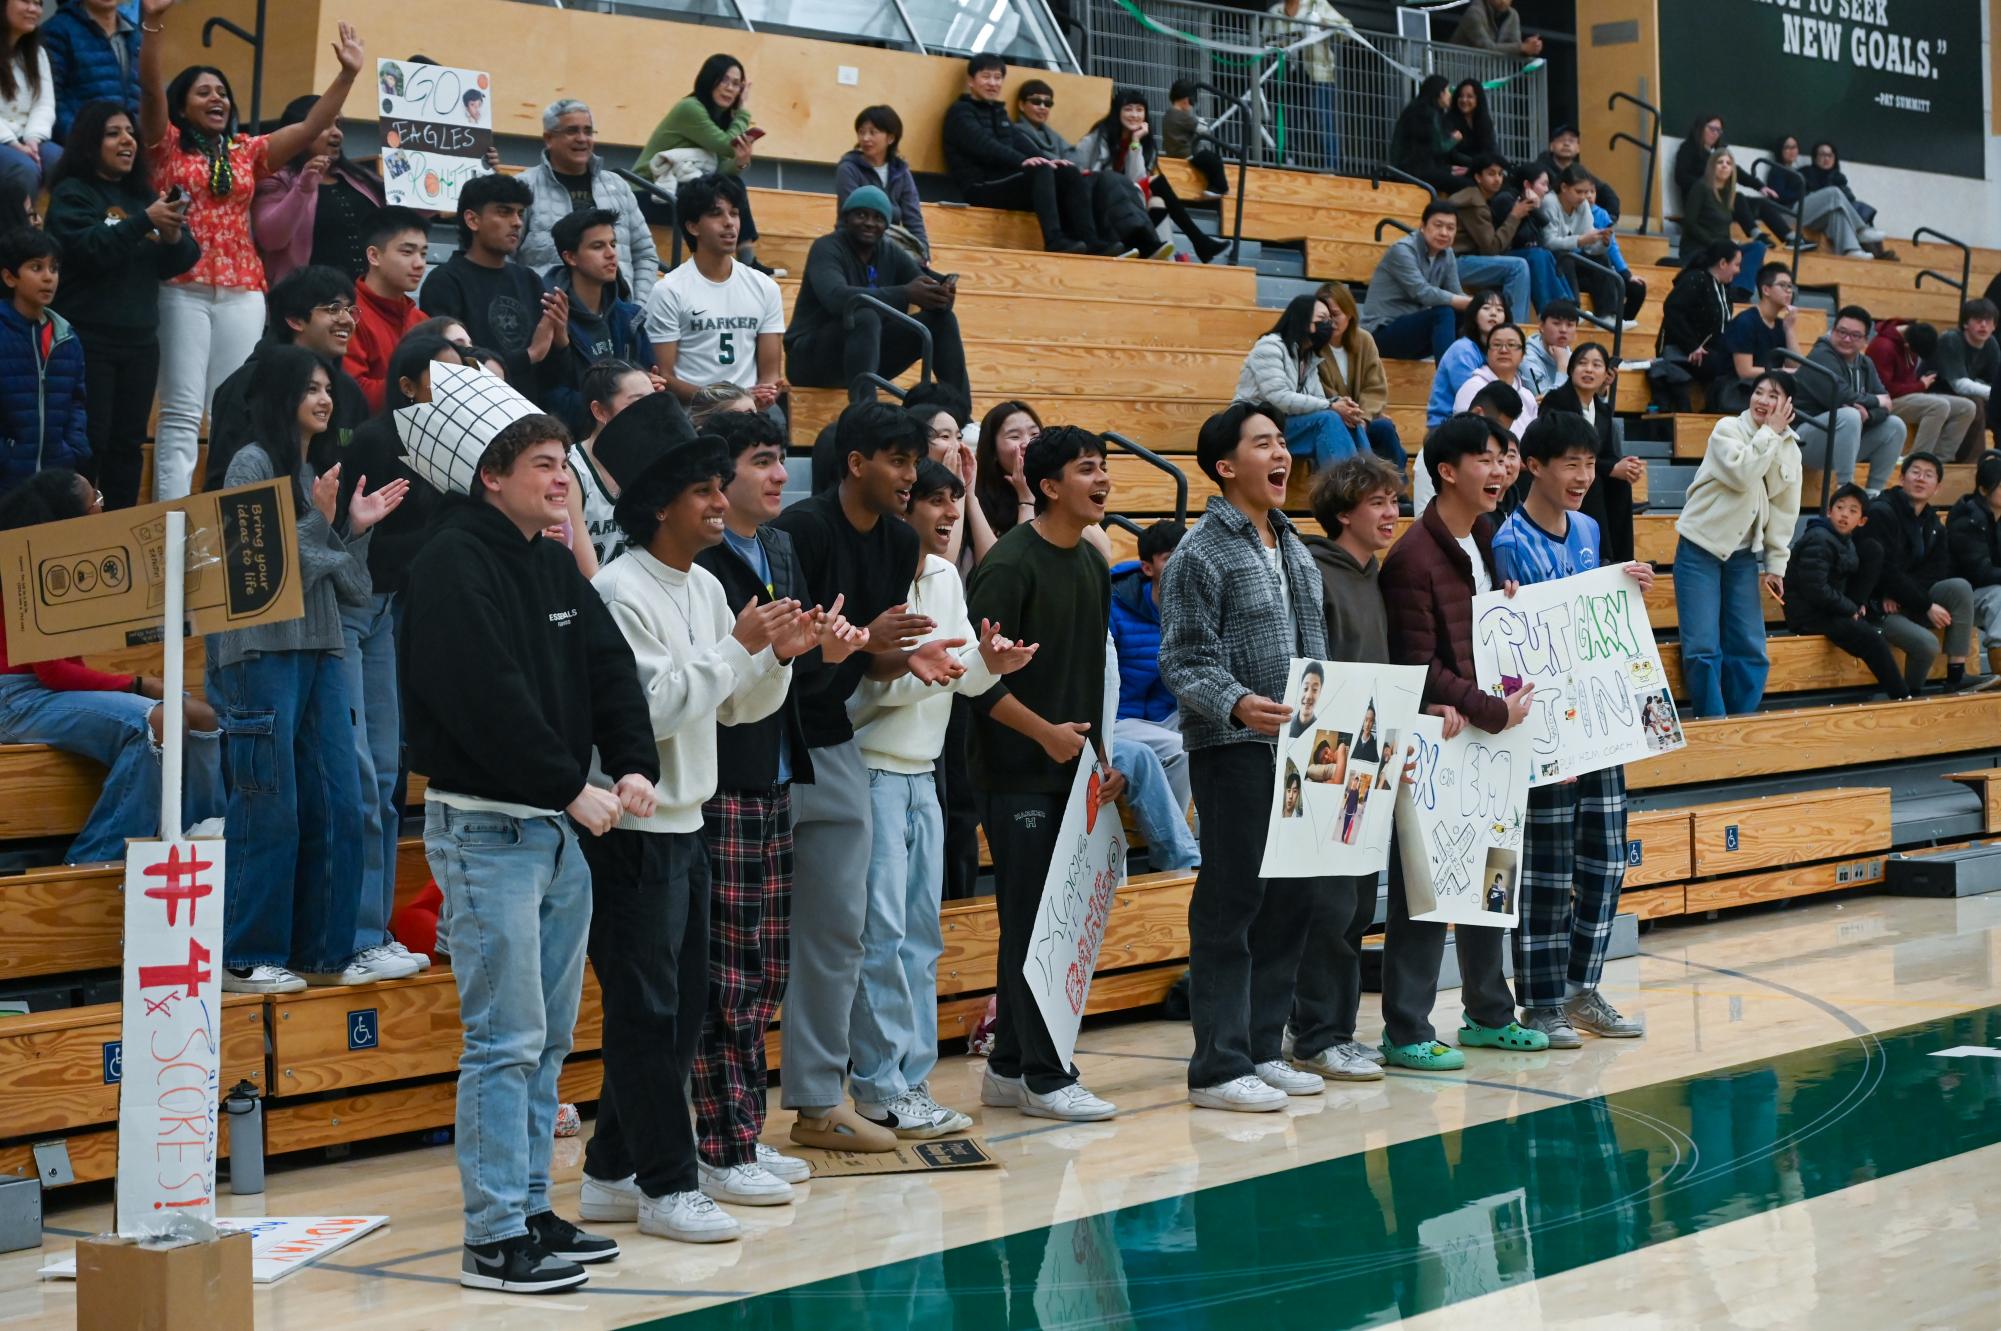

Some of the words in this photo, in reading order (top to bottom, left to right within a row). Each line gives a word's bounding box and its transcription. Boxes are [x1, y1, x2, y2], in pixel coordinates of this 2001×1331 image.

[1840, 0, 1888, 26] SEEK
[1782, 13, 1842, 62] NEW
[404, 65, 461, 117] GO
[1895, 94, 1931, 113] SUMMITT
[392, 120, 475, 150] EAGLES
[690, 316, 758, 331] HARKER
[719, 333, 735, 365] 5
[236, 504, 249, 544] ideas
[251, 504, 264, 547] Bring
[242, 549, 252, 566] to
[254, 553, 269, 591] your
[244, 572, 257, 596] life
[1479, 602, 1572, 677] PUT
[1574, 590, 1639, 661] GARY
[1531, 670, 1634, 755] JIN
[151, 1028, 210, 1210] SCORES!
[255, 1218, 369, 1262] ADVAY
